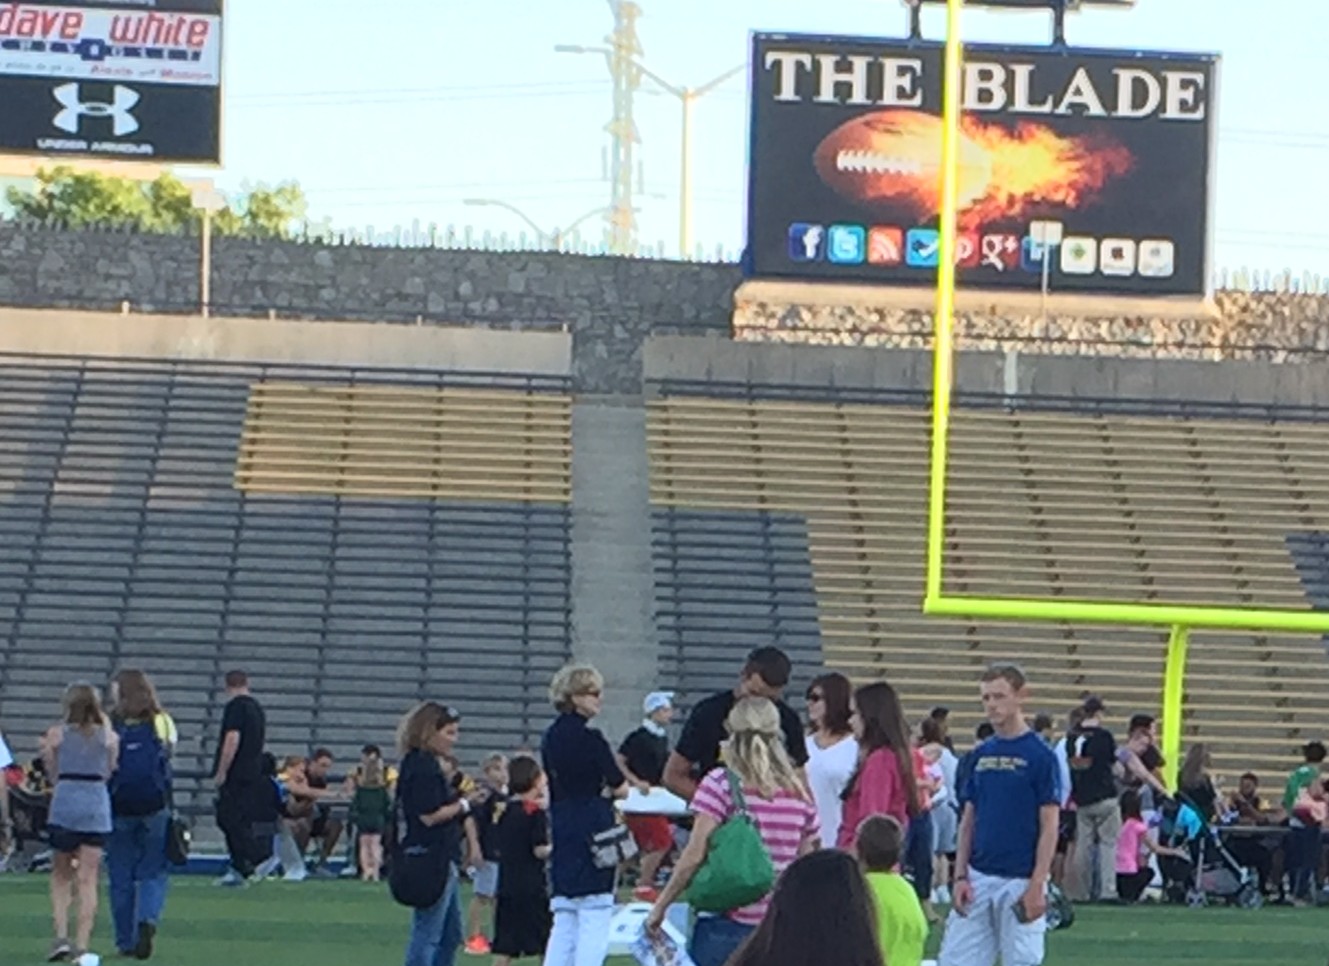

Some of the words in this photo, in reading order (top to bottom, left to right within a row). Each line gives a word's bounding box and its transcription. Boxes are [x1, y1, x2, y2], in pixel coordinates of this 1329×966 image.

[0, 4, 83, 39] dave
[110, 12, 209, 47] white
[765, 51, 923, 106] THE
[961, 62, 1205, 120] BLADE
